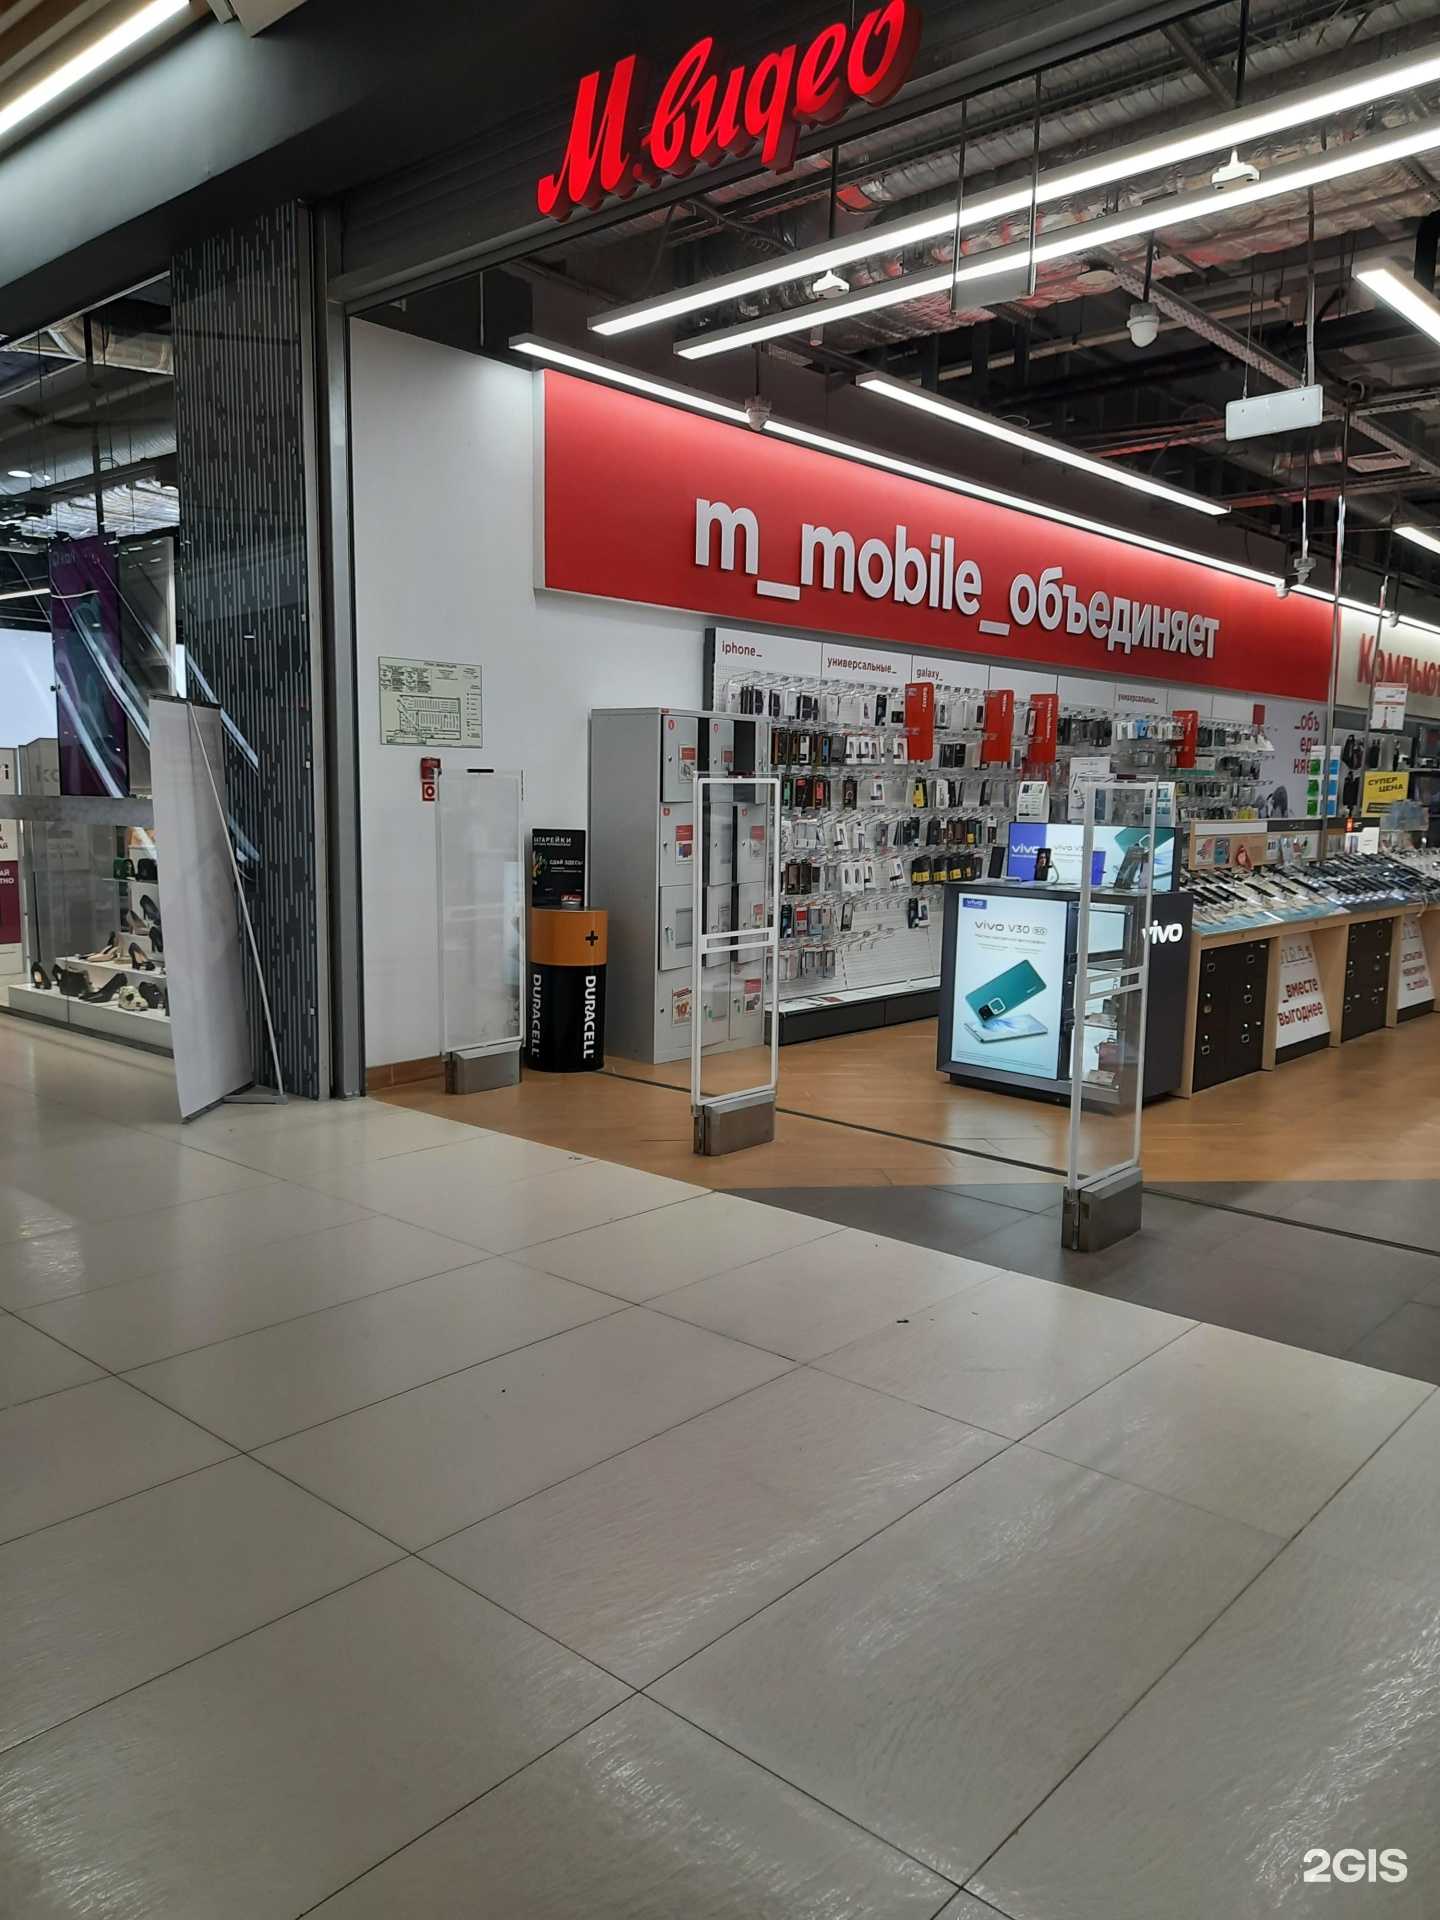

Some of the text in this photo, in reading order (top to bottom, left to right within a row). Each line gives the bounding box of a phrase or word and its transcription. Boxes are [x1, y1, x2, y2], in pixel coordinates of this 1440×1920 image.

[695, 497, 1220, 659] m_mobile_объединяет
[721, 640, 763, 658] iphone_
[827, 656, 897, 674] универсальные_
[916, 667, 943, 681] galaxy_
[1357, 632, 1440, 698] Компью
[1368, 776, 1398, 786] СУПЕР
[1378, 784, 1404, 792] ЦЕНА
[974, 920, 1005, 932] vivo
[1008, 924, 1030, 934] V30
[531, 973, 542, 1057] DURACELL
[583, 975, 597, 1059] DURACELL
[1277, 1000, 1324, 1027] выгоднее
